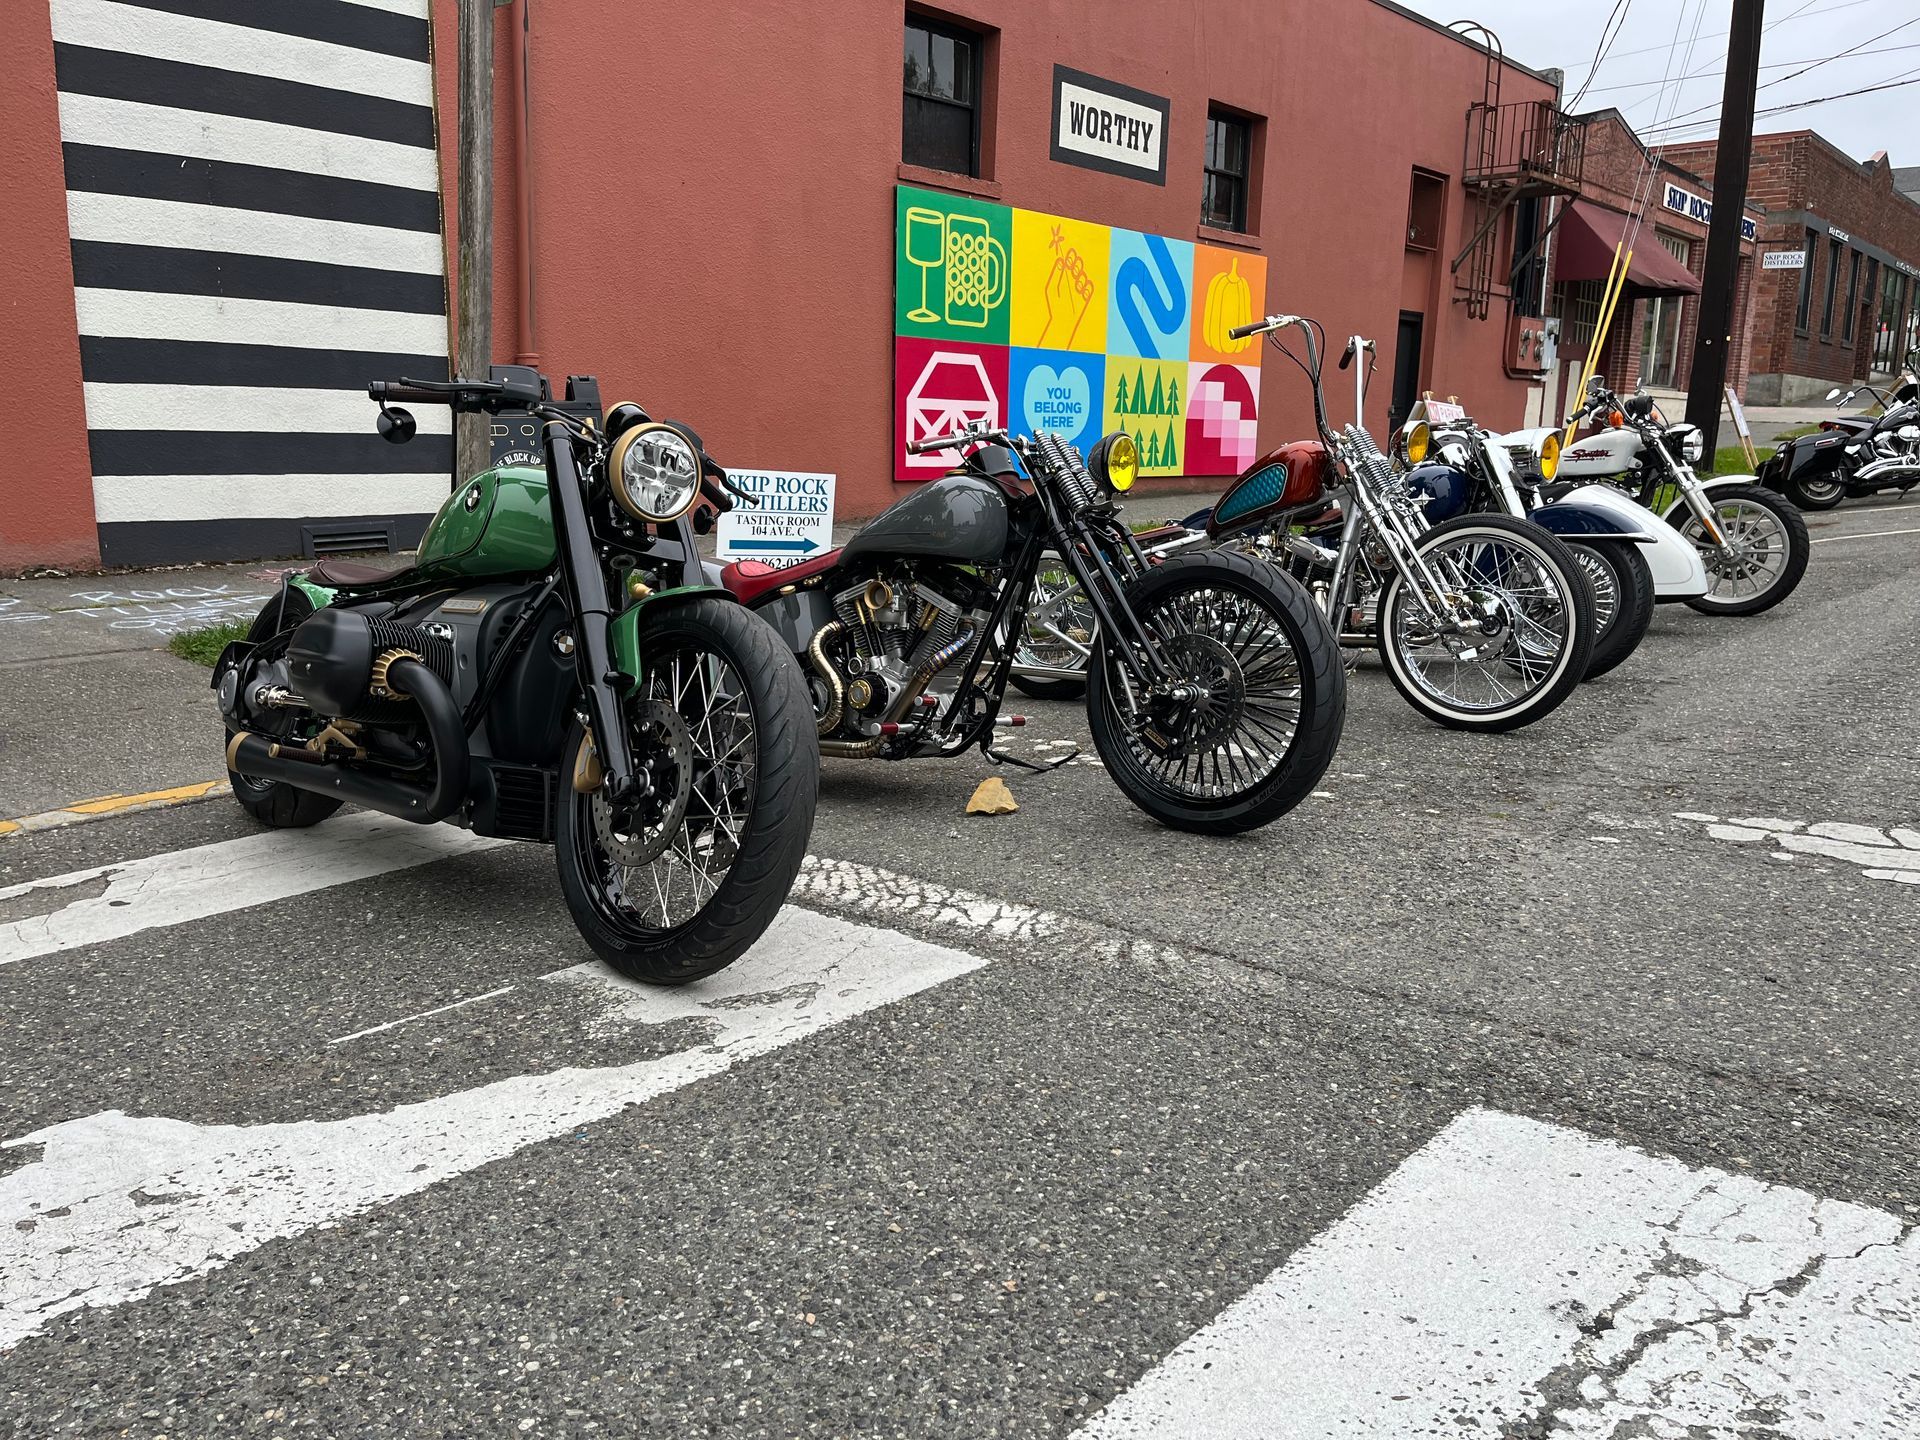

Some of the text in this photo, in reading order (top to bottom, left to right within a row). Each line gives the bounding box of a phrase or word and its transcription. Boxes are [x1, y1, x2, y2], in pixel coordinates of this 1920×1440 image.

[1069, 100, 1154, 154] WORTHY
[1667, 187, 1688, 212] SKIP
[1046, 387, 1072, 400] YOU
[1034, 401, 1082, 414] BELONG
[1042, 415, 1074, 428] HERE
[504, 453, 529, 465] BLOCK
[530, 455, 541, 465] UP
[727, 474, 829, 496] SKIP ROCK
[727, 493, 828, 512] DISTILLERS
[735, 514, 820, 527] TASTING ROOM
[751, 525, 806, 537] 104 AVE. C
